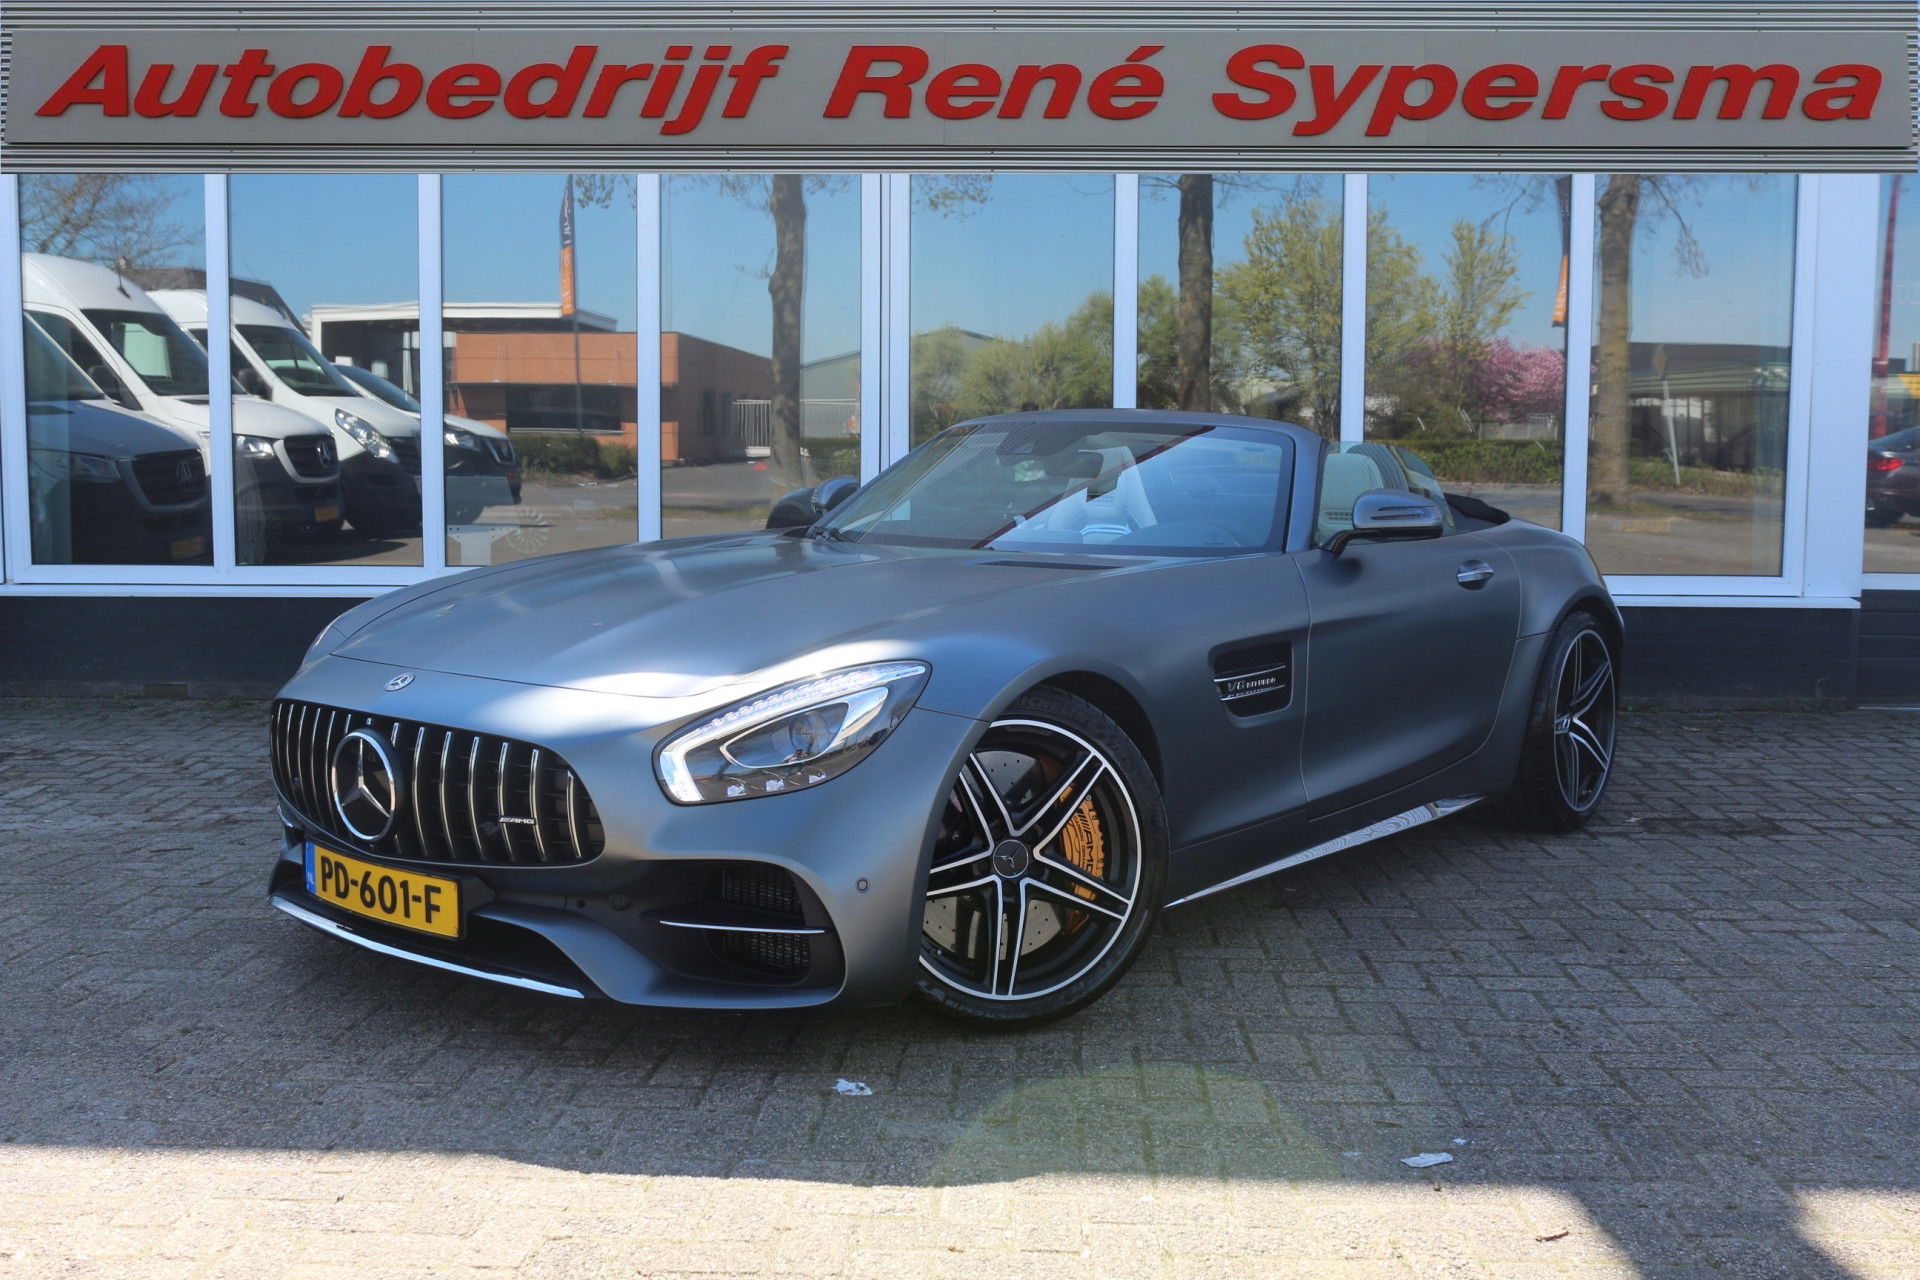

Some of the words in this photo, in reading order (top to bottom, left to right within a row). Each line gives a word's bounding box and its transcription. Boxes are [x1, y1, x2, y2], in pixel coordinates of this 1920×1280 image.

[36, 44, 789, 136] Autobedrijf
[823, 45, 1166, 120] René
[1211, 43, 1884, 137] Sypersma
[320, 855, 442, 924] PD-601-F
